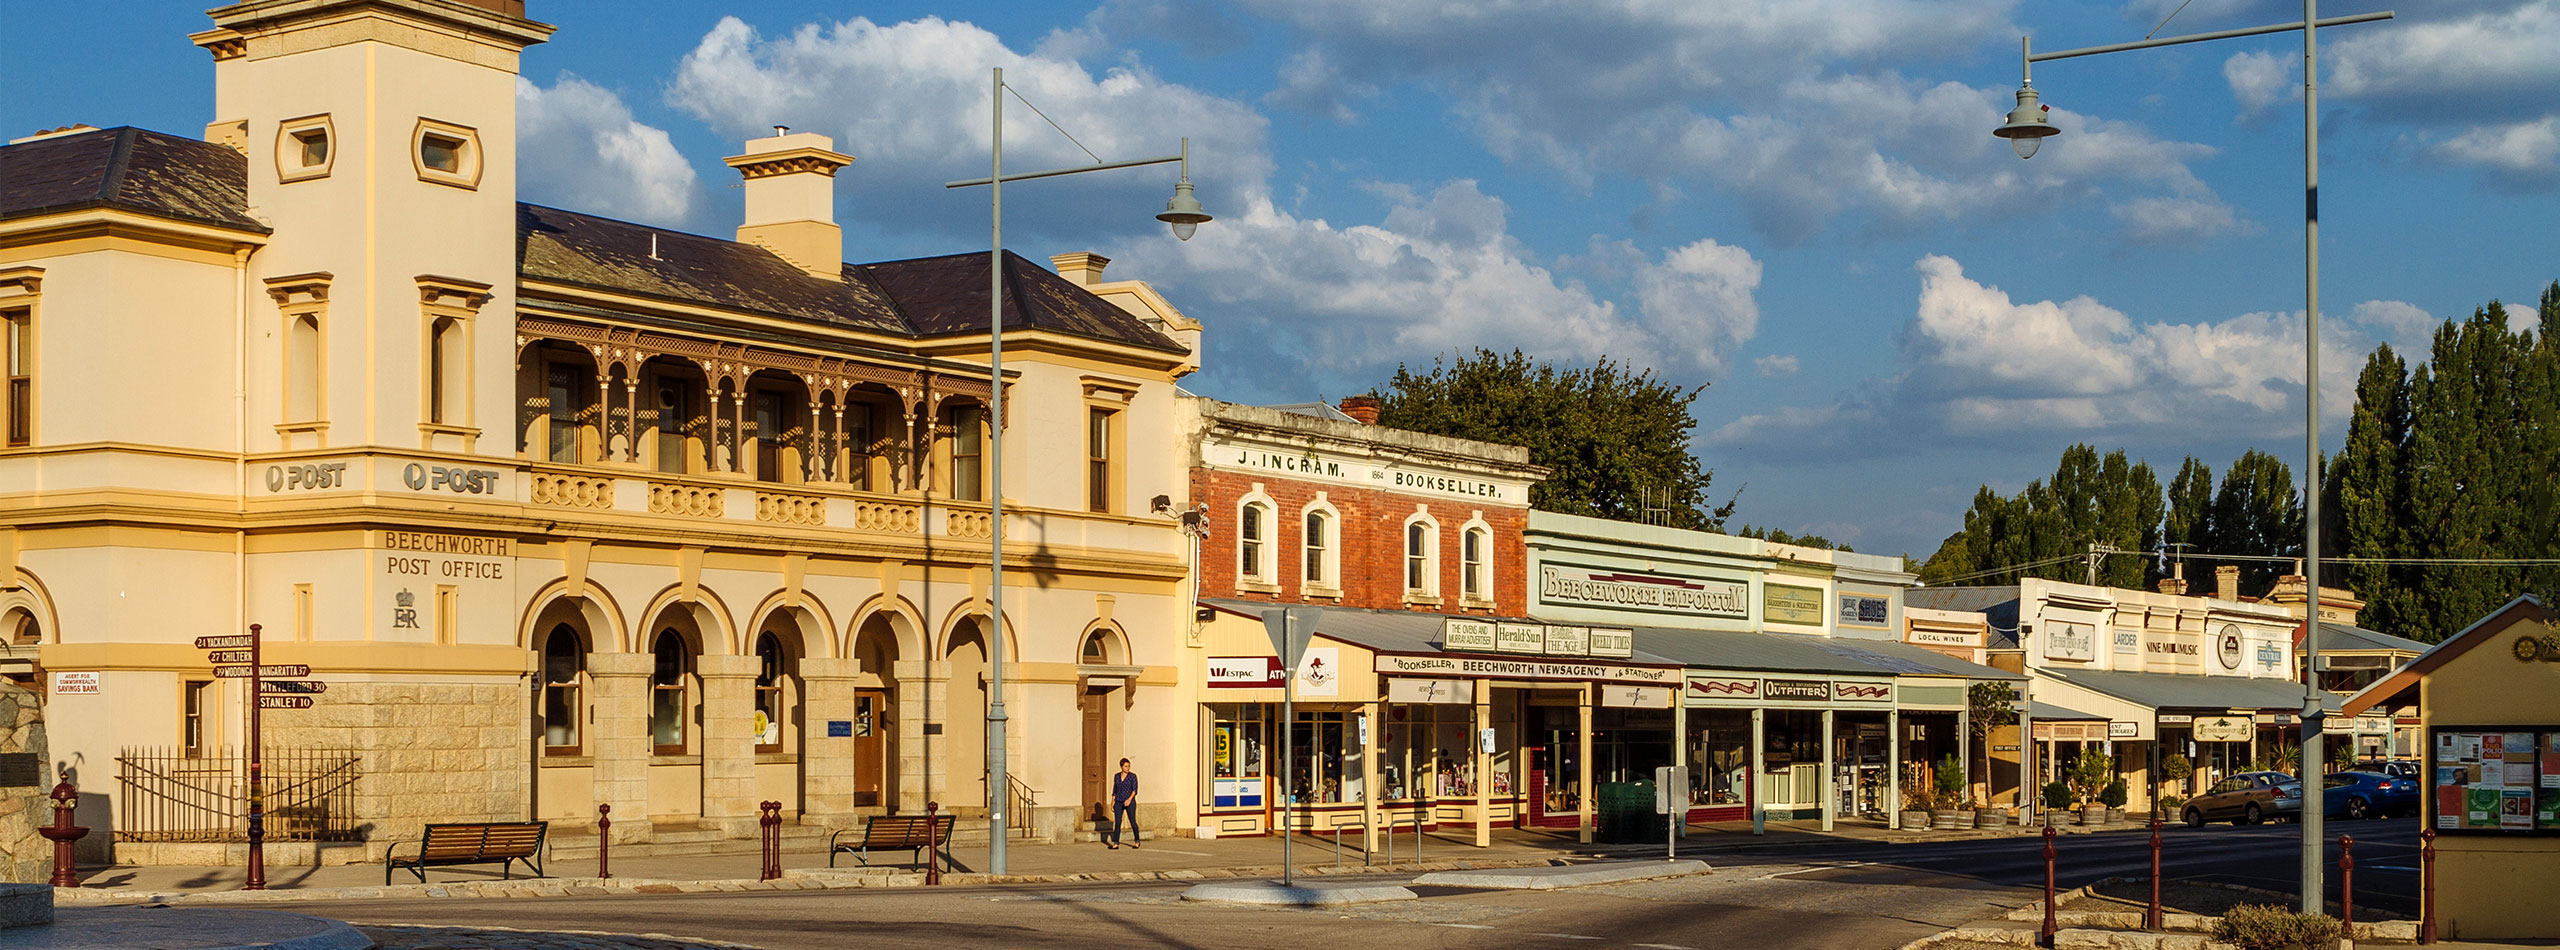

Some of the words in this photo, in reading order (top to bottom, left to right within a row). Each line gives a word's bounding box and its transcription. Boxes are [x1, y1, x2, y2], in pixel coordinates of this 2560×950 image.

[1262, 453, 1345, 478] INGRAM.
[288, 462, 346, 490] POST
[431, 466, 500, 495] POST
[1371, 470, 1384, 480] 1864
[1396, 472, 1502, 499] BOOKSELLER.
[385, 531, 508, 556] BEECHWORTH
[387, 557, 431, 576] POST
[441, 560, 503, 580] OFFICE
[1544, 567, 1660, 606] BEECHWORTH
[1662, 585, 1745, 613] EMPORIUM
[1858, 598, 1887, 621] SHOES
[1452, 624, 1461, 634] THE
[1462, 624, 1477, 634] OVENS
[1478, 625, 1488, 635] AND
[198, 638, 206, 647] 24
[207, 636, 253, 648] YACKANDANDAH
[1448, 634, 1466, 644] MURRAY
[1466, 635, 1492, 646] ADVERTISER
[1591, 634, 1613, 649] WEEKLY
[1614, 635, 1631, 650] TIMES
[1918, 634, 1940, 642] LOCAL
[1943, 635, 1964, 643] WINES
[2113, 633, 2137, 646] LARDER
[1547, 640, 1564, 652] THE
[1564, 640, 1579, 652] AGE
[2146, 642, 2161, 654] NINE
[211, 652, 220, 662] 27
[222, 651, 253, 662] CHILTERN
[215, 667, 224, 677] 39
[224, 666, 253, 678] WODONGA
[259, 665, 298, 677] WANGARATTA
[298, 666, 307, 676] 37
[1463, 660, 1534, 674] BEECHWORTH
[1539, 664, 1607, 677] NEWSAGENCY
[260, 681, 312, 693] MYRTLEFORD
[313, 682, 325, 692] 30
[1766, 683, 1828, 698] OUTFITTERS
[260, 697, 298, 708] STANLEY
[300, 697, 310, 707] 10
[1215, 734, 1227, 751] 15
